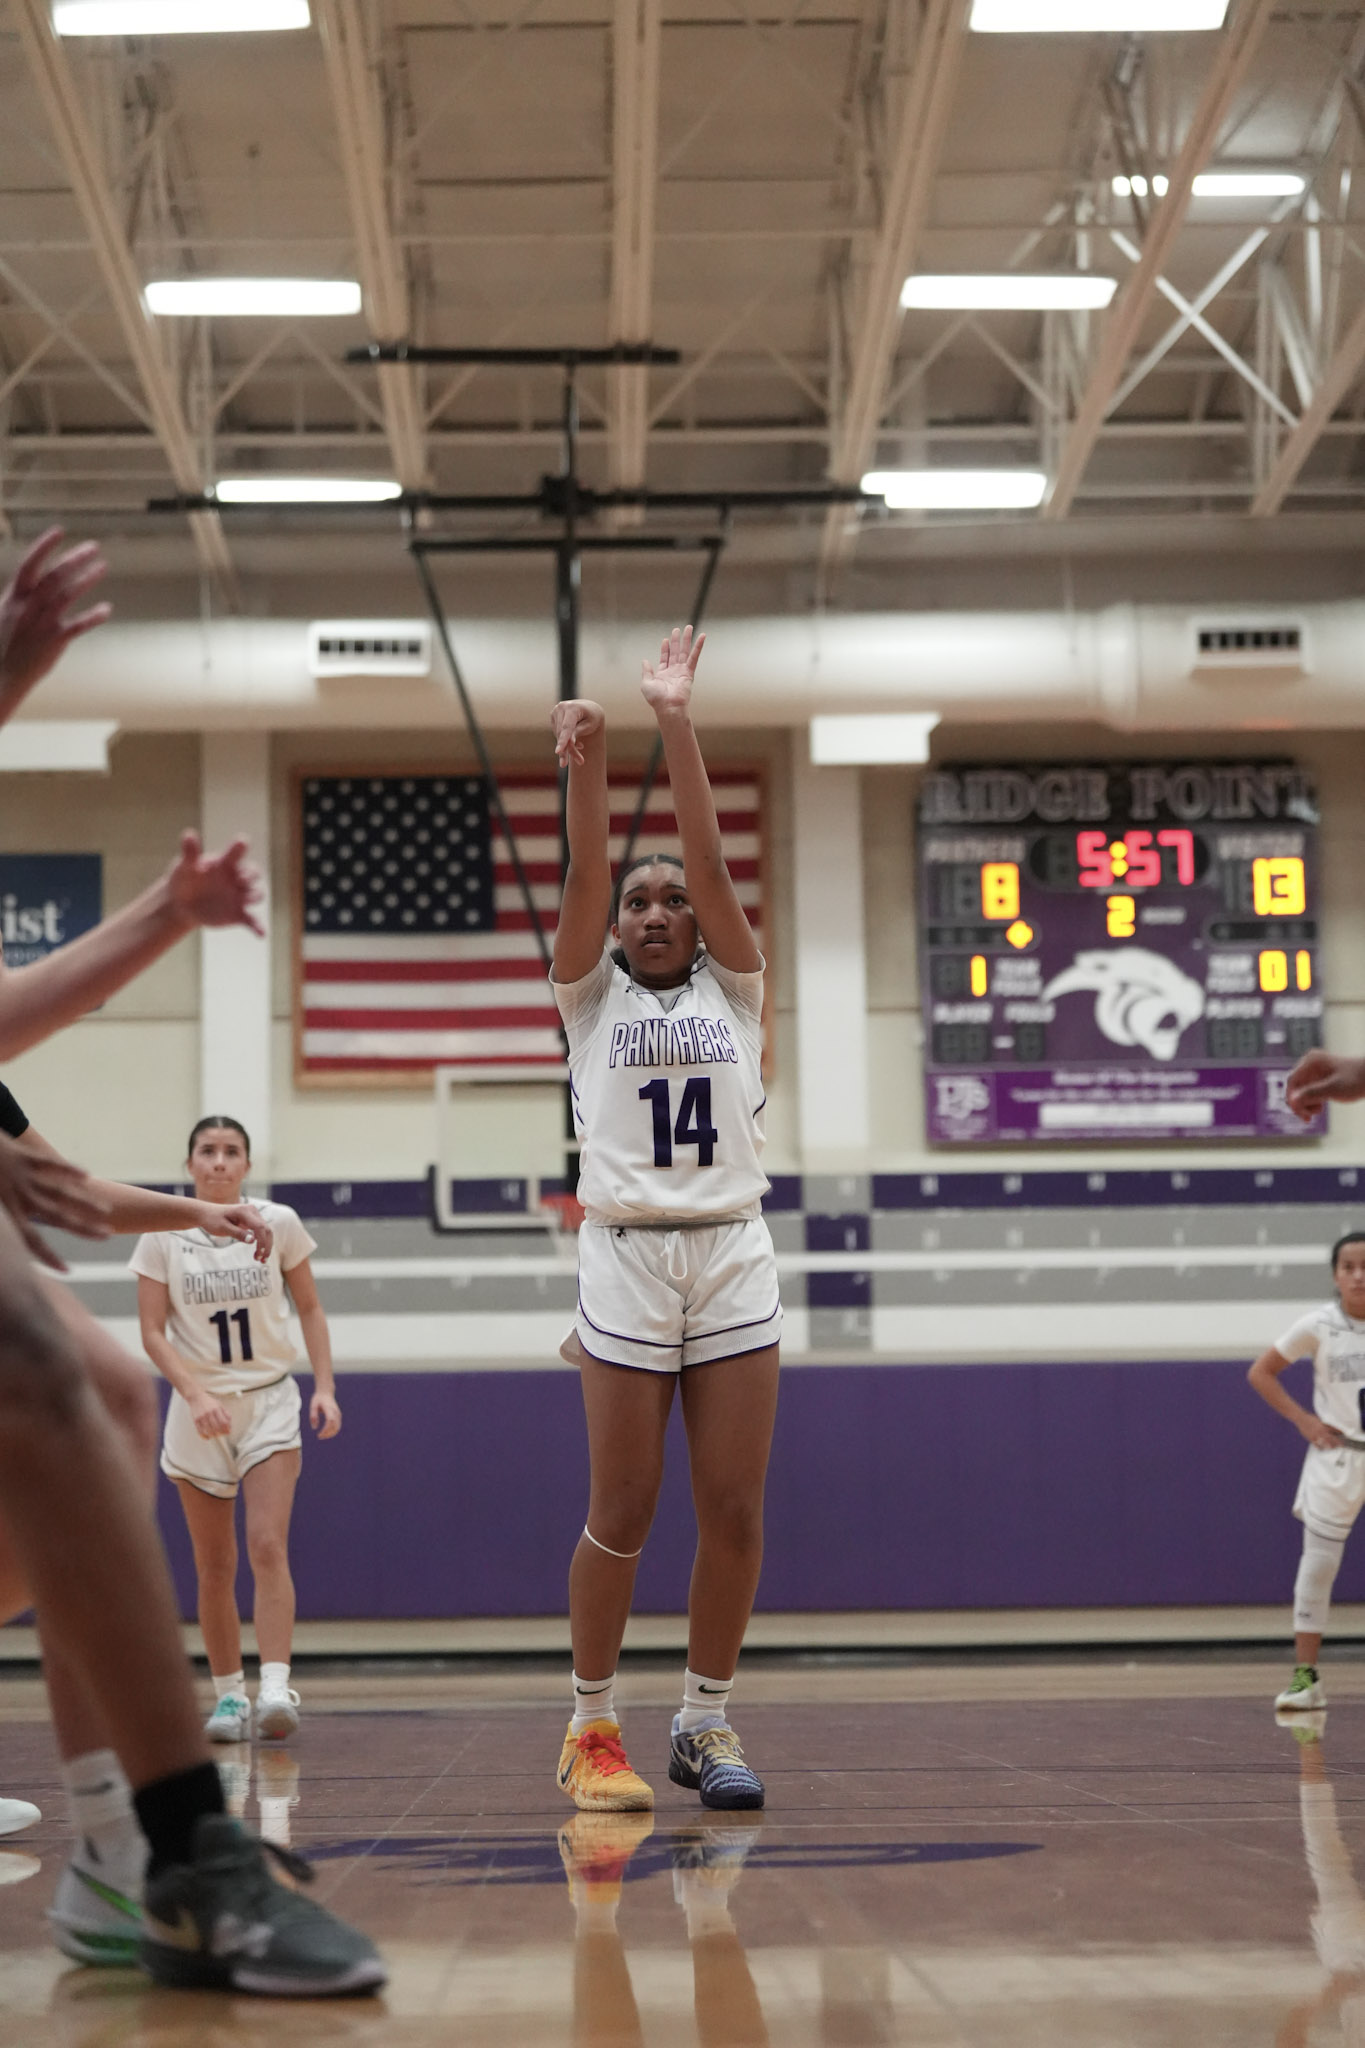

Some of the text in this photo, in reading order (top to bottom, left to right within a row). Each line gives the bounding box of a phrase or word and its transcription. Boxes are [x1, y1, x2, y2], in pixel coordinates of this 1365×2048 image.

[920, 766, 1313, 823] RIDGE POINT
[1077, 829, 1194, 887] 5:57
[1253, 857, 1306, 916] 13
[981, 862, 1020, 920] 8
[1106, 895, 1136, 938] 2
[970, 954, 987, 997] 1
[609, 1016, 739, 1069] PANTHERS
[638, 1076, 718, 1168] 14
[183, 1266, 273, 1305] PANTHERS
[208, 1307, 254, 1364] 11
